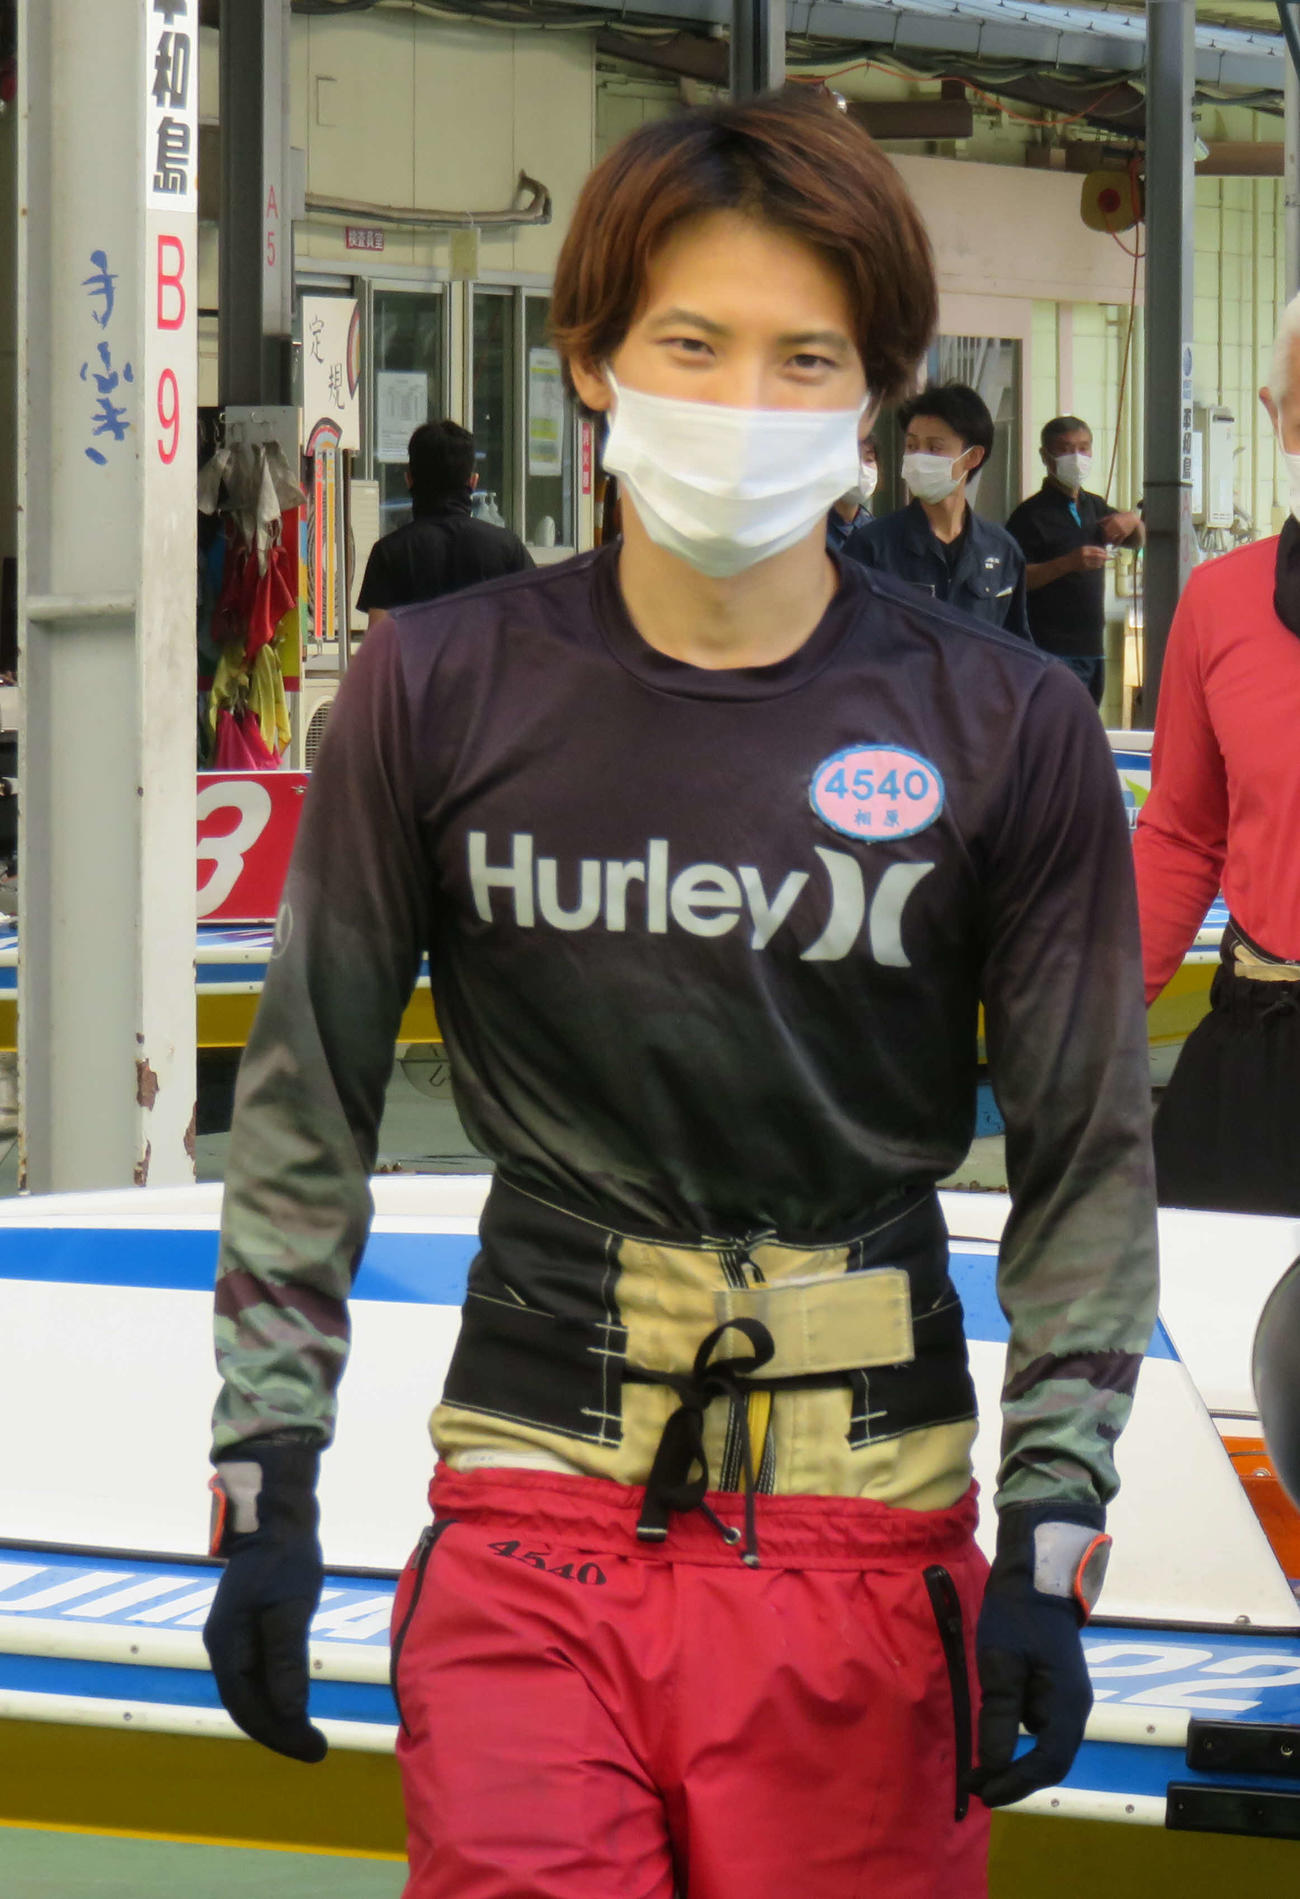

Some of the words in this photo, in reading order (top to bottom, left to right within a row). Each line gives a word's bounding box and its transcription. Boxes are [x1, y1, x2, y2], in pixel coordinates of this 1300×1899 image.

[308, 314, 345, 410] 定規
[824, 767, 929, 801] 4540
[467, 830, 809, 950] Hurley
